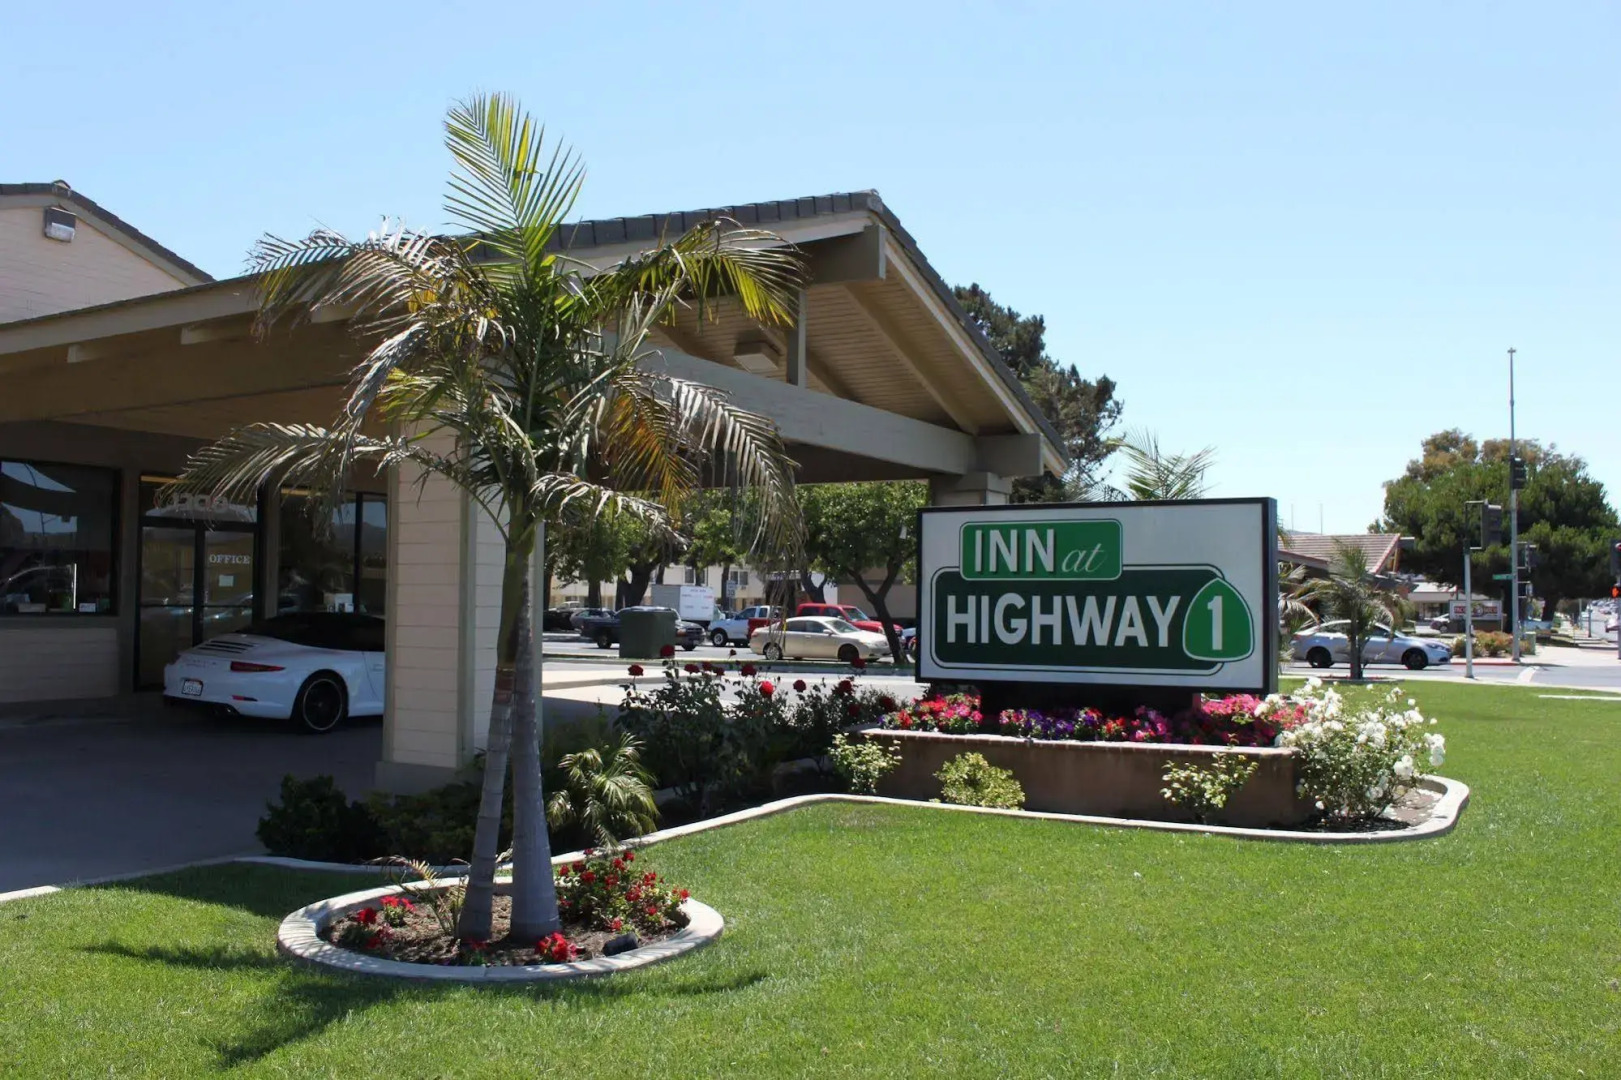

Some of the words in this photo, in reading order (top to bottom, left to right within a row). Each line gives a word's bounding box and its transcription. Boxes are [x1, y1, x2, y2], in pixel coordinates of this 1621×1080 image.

[209, 554, 251, 565] OFFICE
[975, 529, 1054, 572] INN
[1061, 543, 1107, 572] at
[947, 592, 1181, 648] HIGHWAY
[1207, 595, 1223, 650] 1
